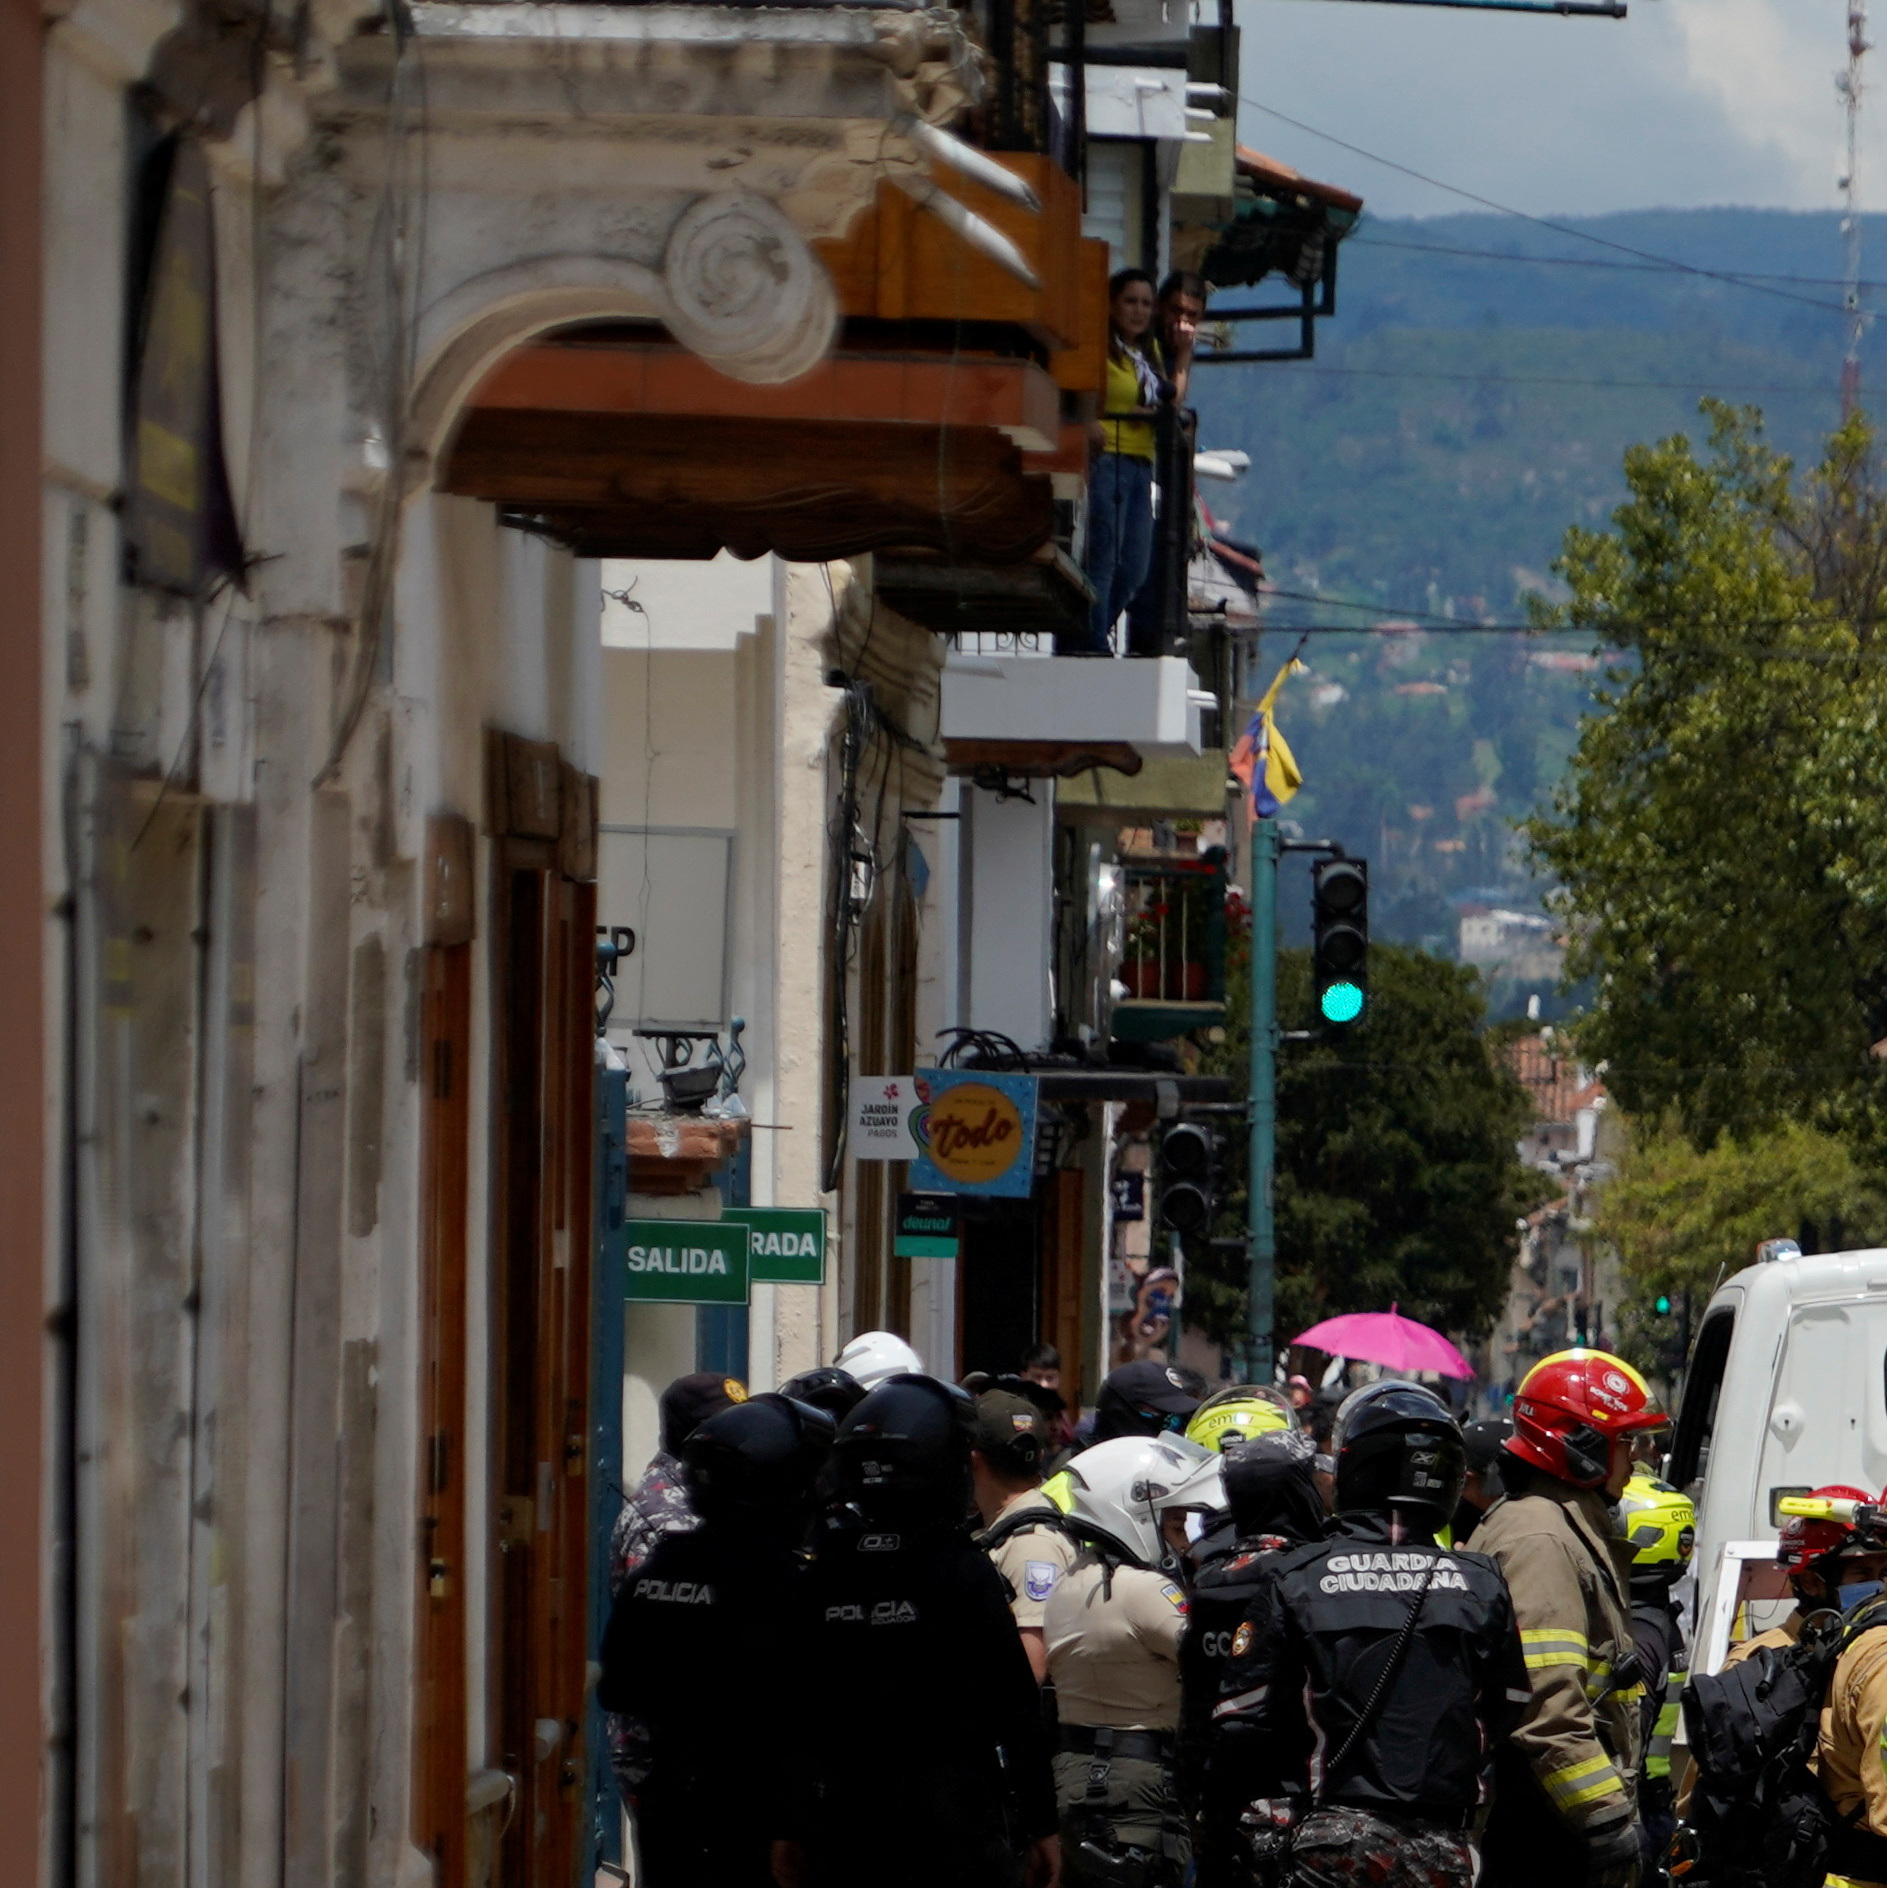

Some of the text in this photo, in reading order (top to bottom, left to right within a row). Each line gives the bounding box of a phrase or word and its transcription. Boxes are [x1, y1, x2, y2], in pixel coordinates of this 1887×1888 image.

[627, 1246, 727, 1275] SALIDA
[1327, 1552, 1458, 1574] GUARDIA
[634, 1579, 712, 1605] POLICIA
[1319, 1572, 1470, 1594] CIUDADANA
[825, 1600, 915, 1623] POLCIA
